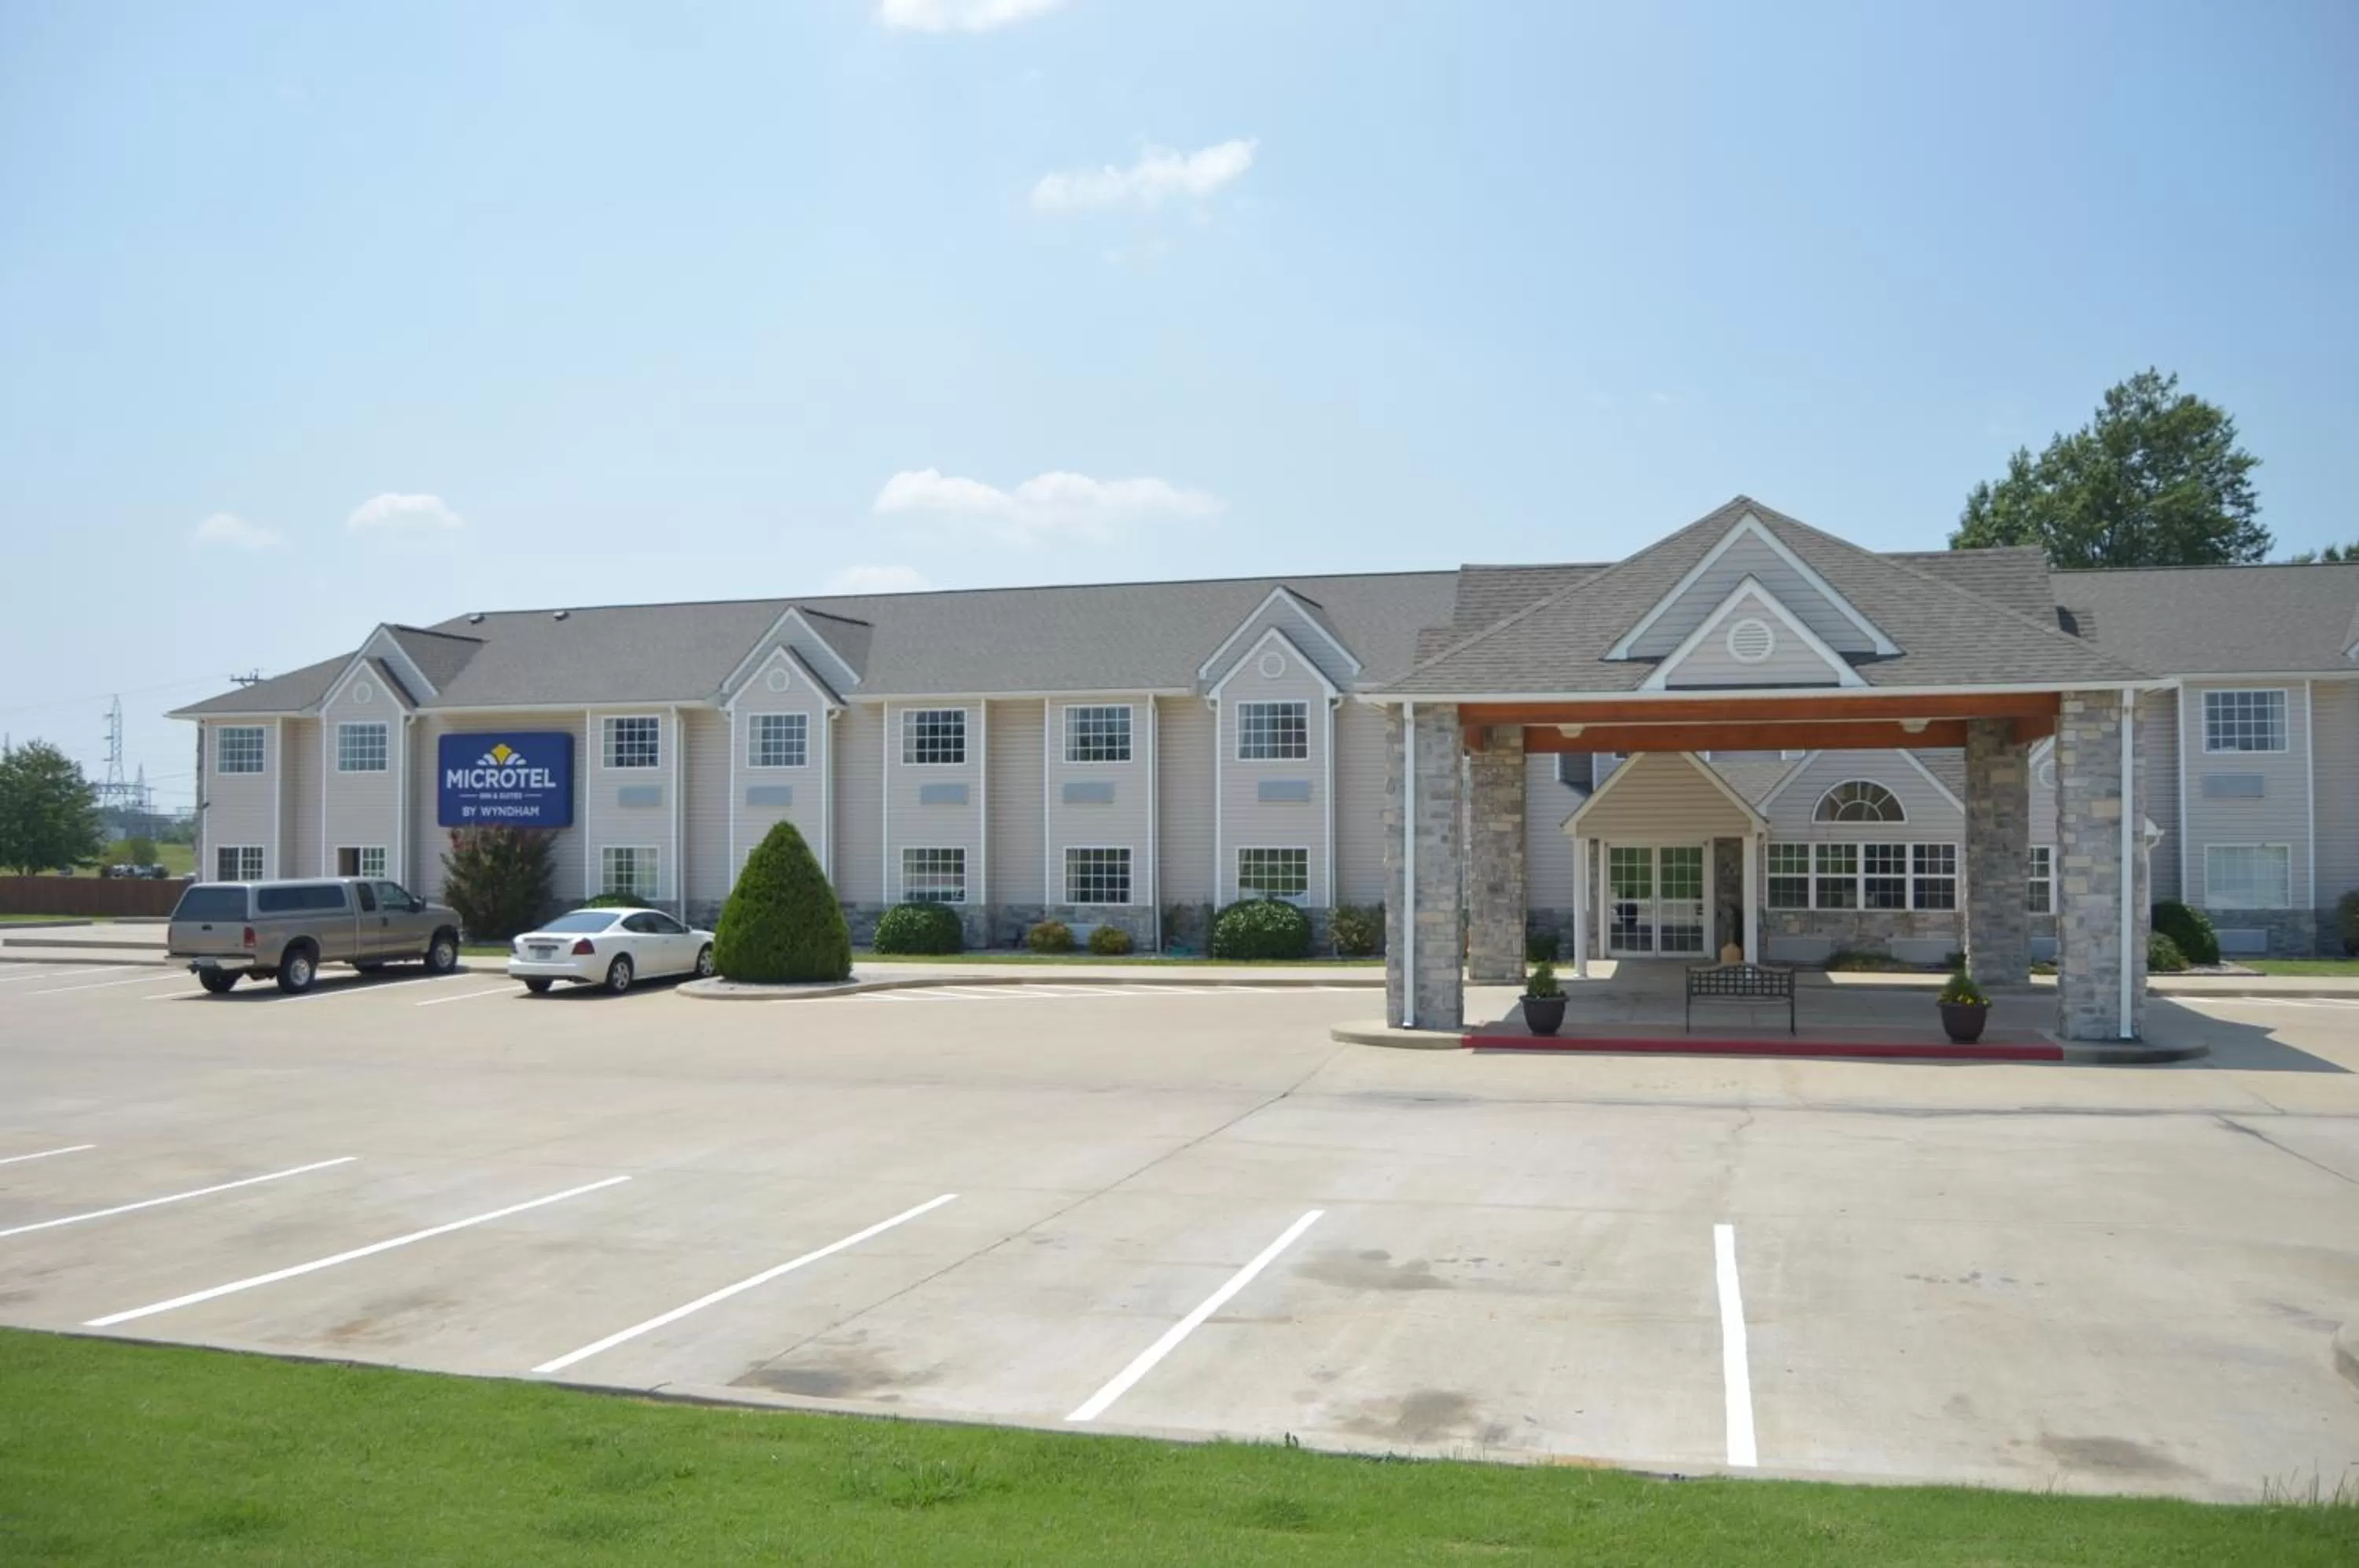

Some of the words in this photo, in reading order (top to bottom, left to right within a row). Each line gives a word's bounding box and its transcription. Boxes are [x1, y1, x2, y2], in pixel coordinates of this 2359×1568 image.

[446, 767, 557, 789] MICROTEL
[462, 806, 476, 817] BY
[481, 806, 540, 817] WYNDHAM
